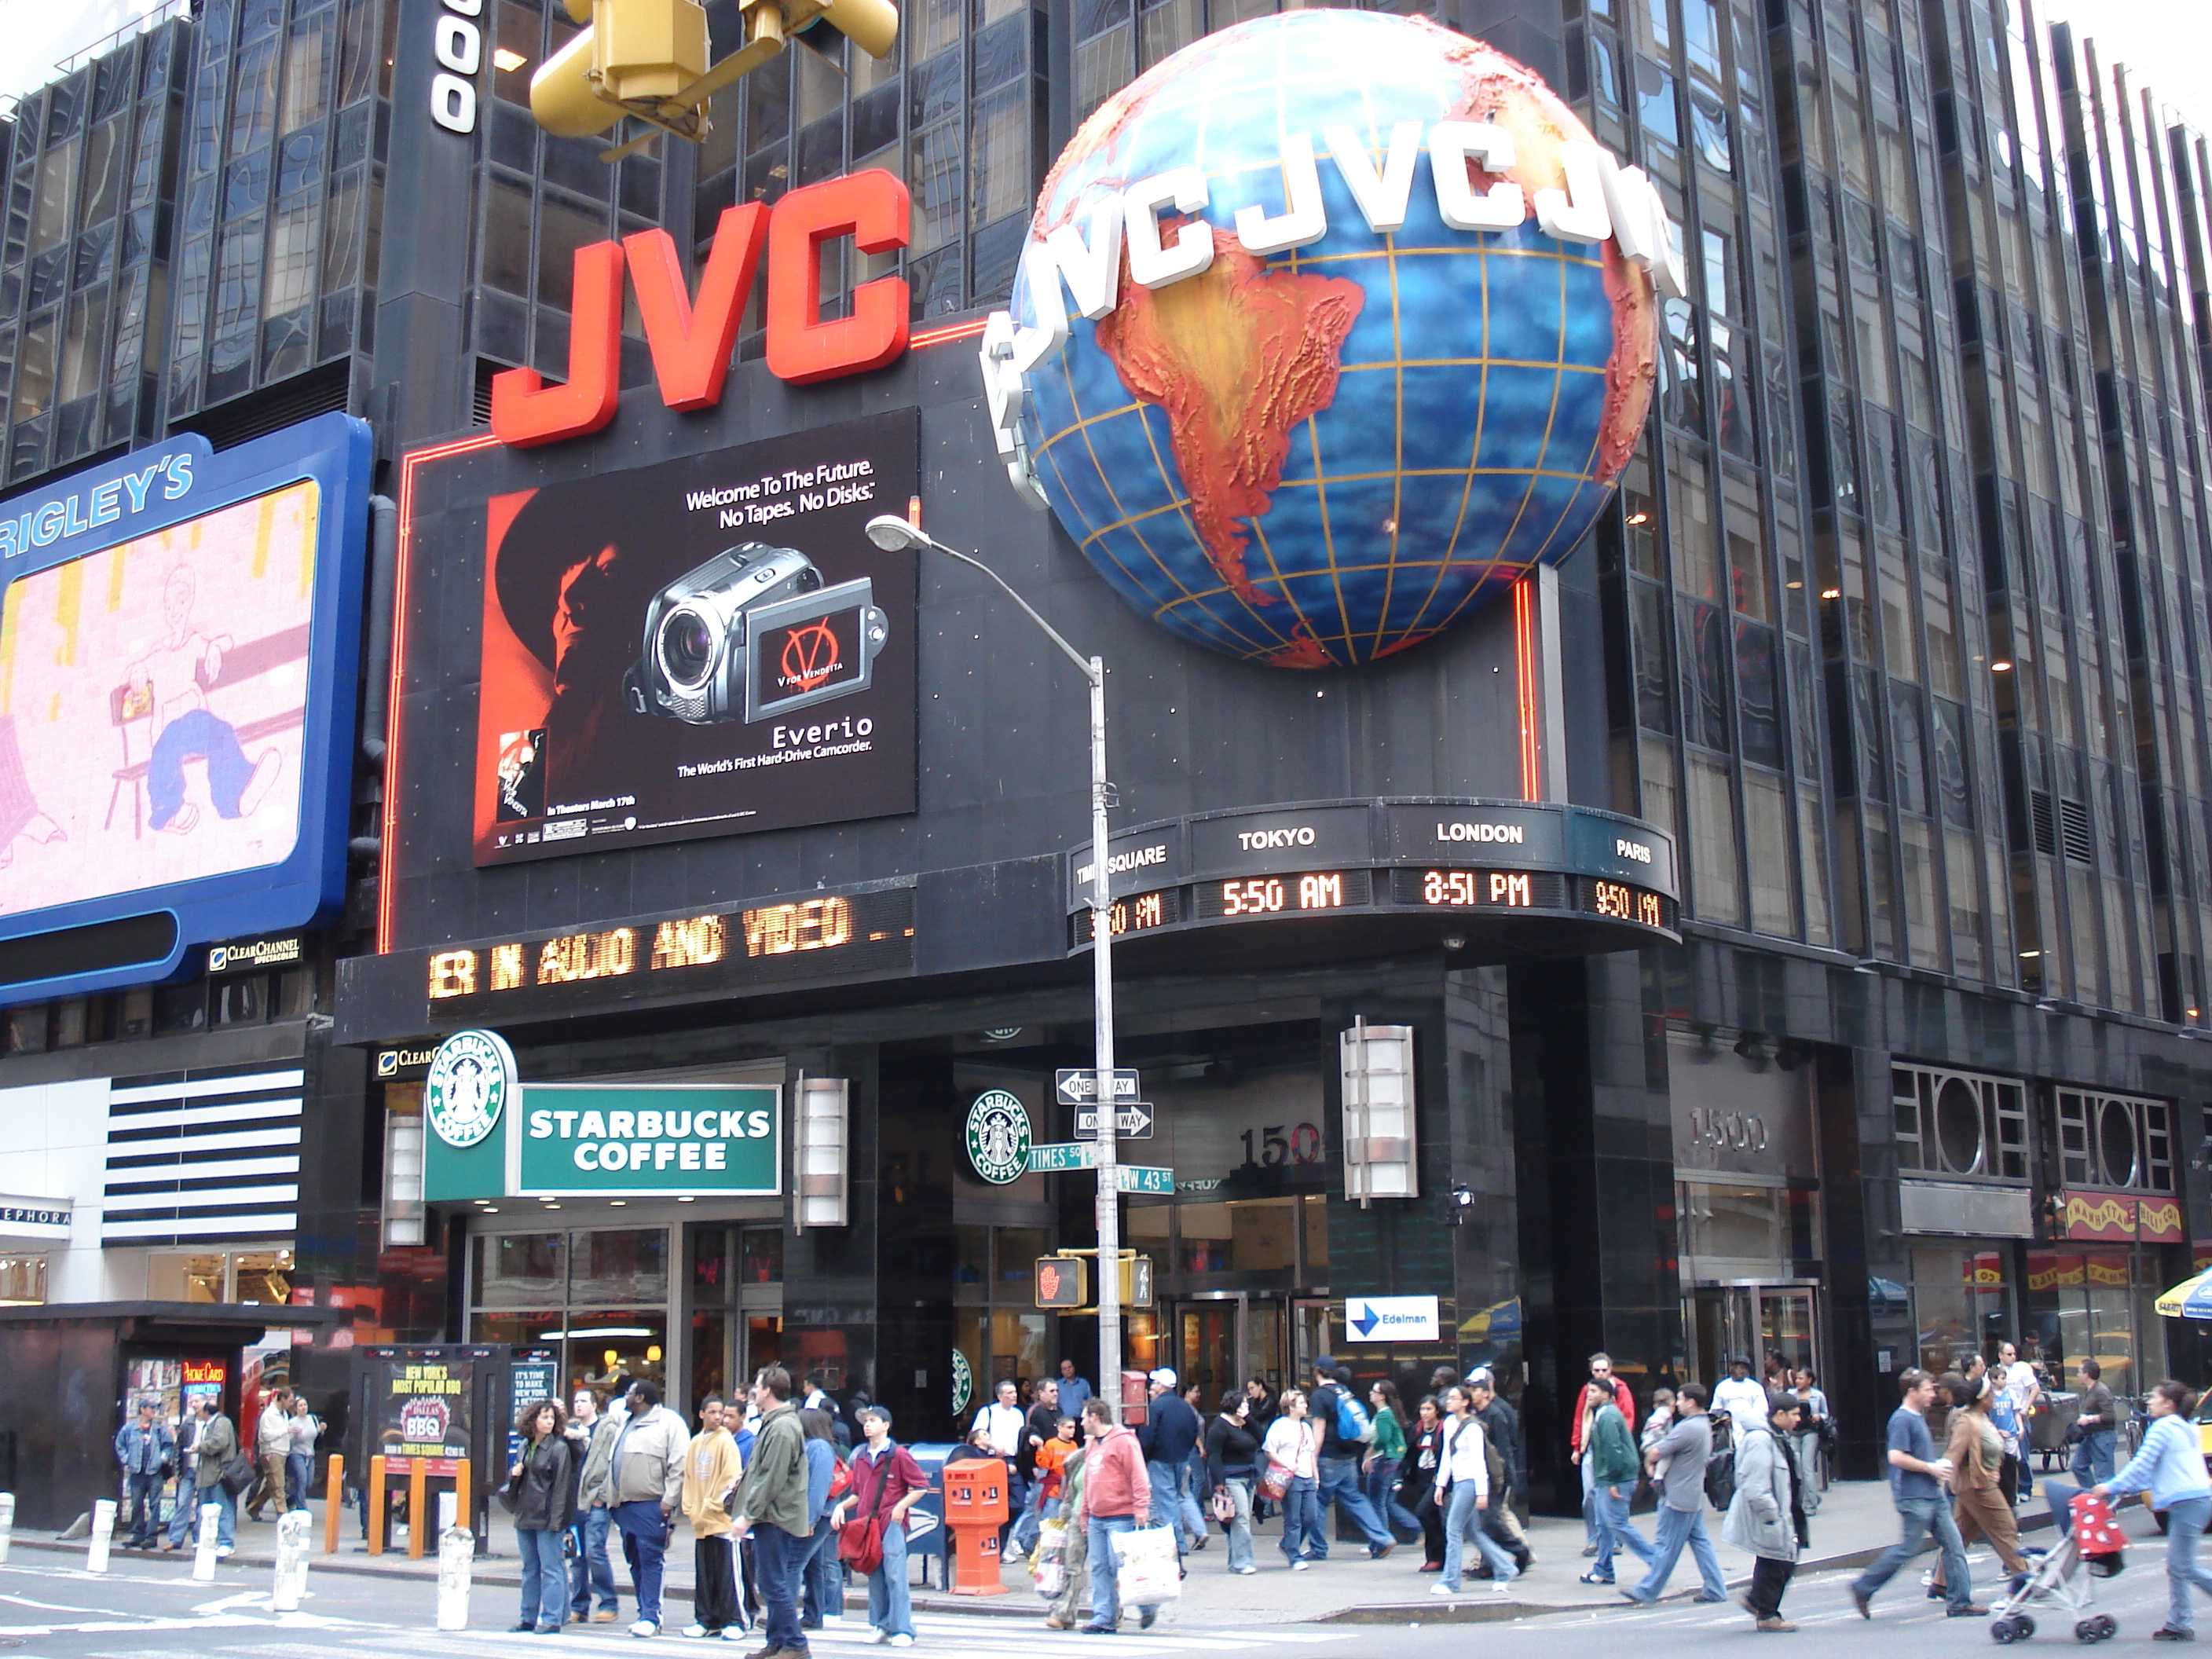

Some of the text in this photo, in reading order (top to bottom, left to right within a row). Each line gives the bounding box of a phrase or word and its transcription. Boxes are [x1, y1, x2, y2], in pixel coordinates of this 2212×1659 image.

[430, 0, 482, 133] 00
[1234, 118, 1526, 258] JVC
[491, 168, 910, 449] JVC
[686, 460, 873, 511] Welcome To The Future.
[719, 508, 744, 529] No
[745, 503, 795, 526] Tapes.
[799, 492, 824, 513] No
[778, 676, 786, 687] V
[772, 716, 873, 749] Everio
[677, 739, 873, 778] The World's First Hard-Drive Camcorder.
[1238, 827, 1316, 851] TOKYO
[1437, 822, 1523, 844] LONDON
[1108, 844, 1167, 874] SQUARE
[1617, 839, 1651, 864] PARIS
[1223, 873, 1342, 915] 5:50 AM
[1490, 873, 1530, 906] PM
[1595, 881, 1631, 920] 9:50
[1136, 892, 1161, 930] PM
[431, 1035, 502, 1089] STARBUCKS
[1069, 1079, 1130, 1093] ONE AY
[435, 1108, 492, 1141] COFFEE
[529, 1110, 771, 1139] STARBUCKS
[969, 1093, 1029, 1138] STARBUCKS
[1086, 1113, 1143, 1127] ON WAY
[573, 1142, 727, 1171] COFFEE
[975, 1153, 1023, 1181] COFFEE
[1031, 1146, 1082, 1169] TIMES SQ
[1129, 1170, 1139, 1189] W
[1144, 1171, 1161, 1191] 43
[1163, 1173, 1172, 1182] ST
[1382, 1314, 1427, 1324] Edelman
[393, 1379, 462, 1394] MOST POPULAR BBQ
[405, 1365, 448, 1379] NEW YORK'S
[515, 1380, 544, 1389] TO MAKE
[407, 1415, 440, 1437] BBQ
